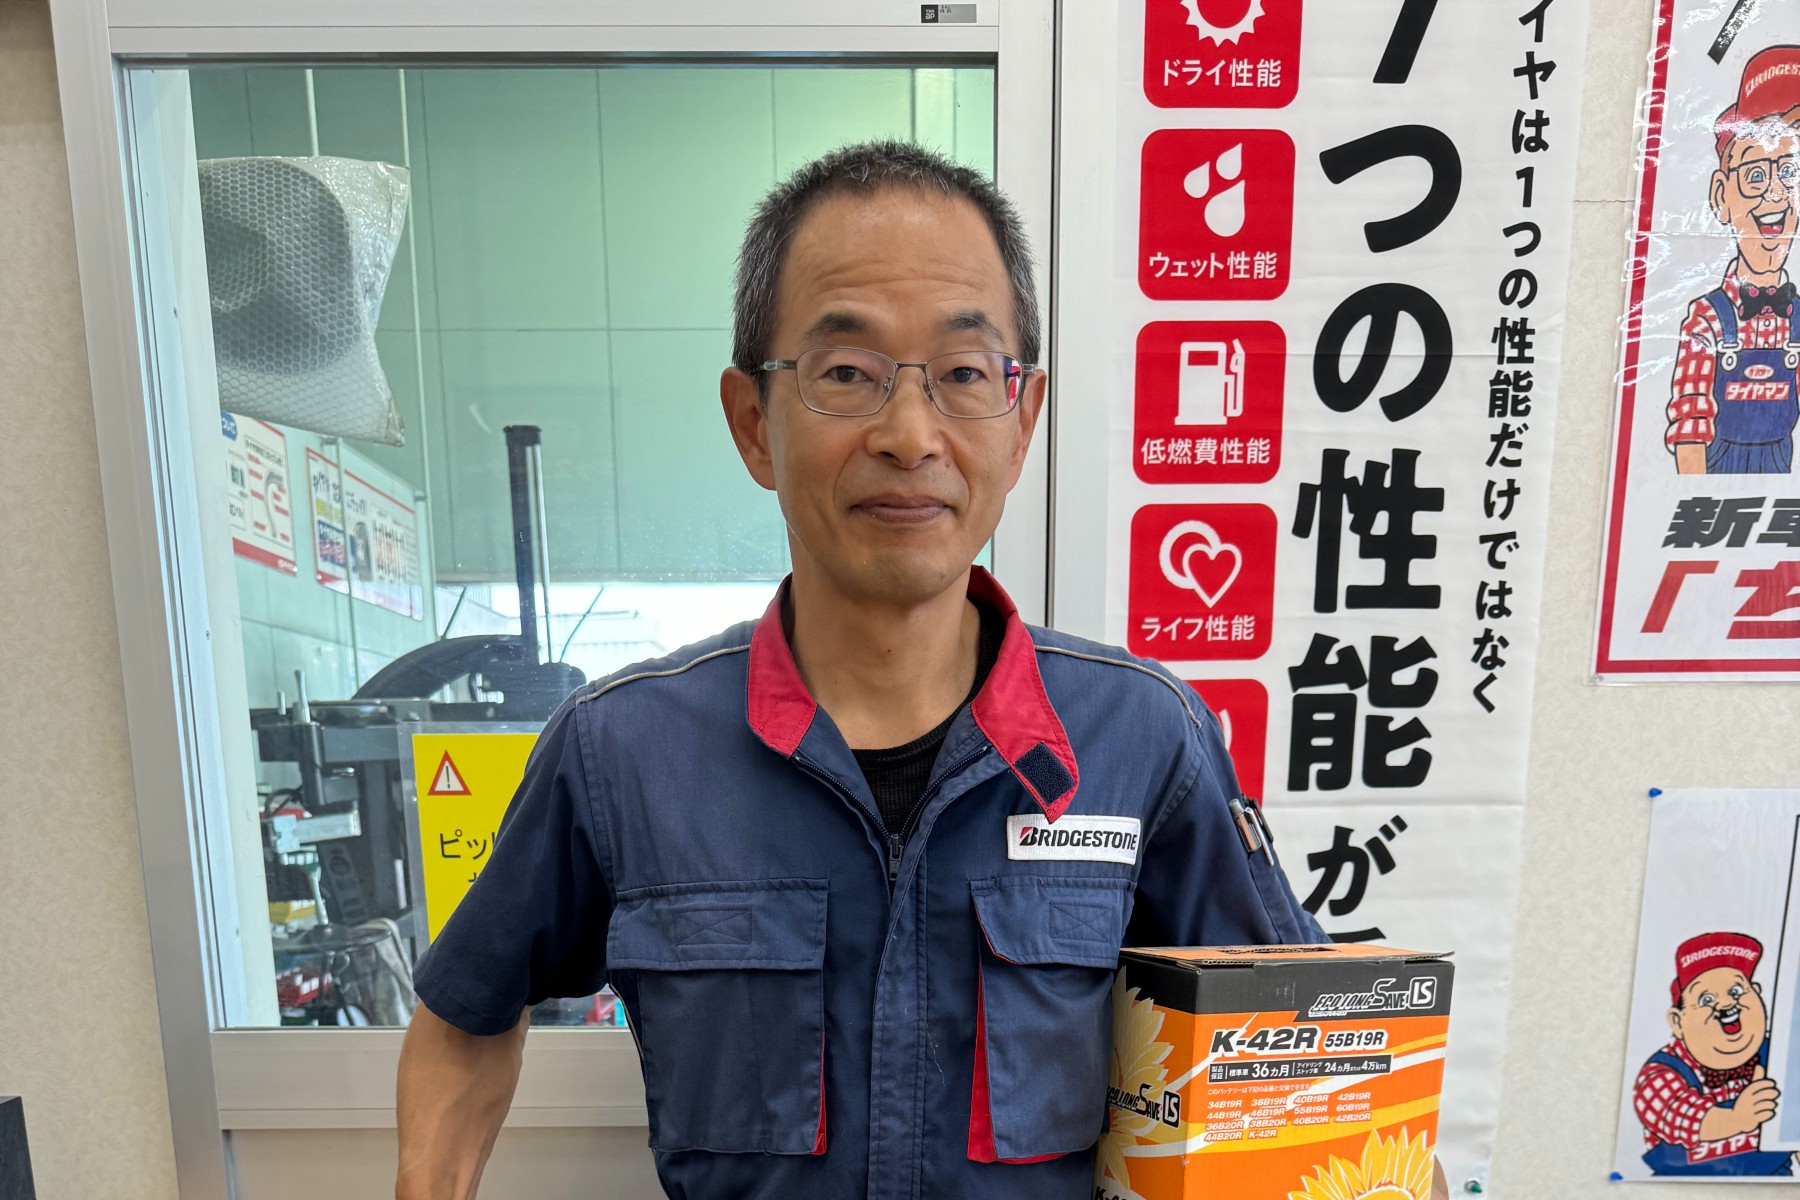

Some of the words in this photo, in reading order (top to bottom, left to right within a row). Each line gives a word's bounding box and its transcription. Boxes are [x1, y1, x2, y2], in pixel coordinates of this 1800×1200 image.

[1162, 59, 1282, 88] ドライ性能
[1745, 63, 1800, 97] BRIDGES
[1148, 251, 1278, 280] ウェット性能
[1726, 382, 1790, 400] タイヤマン
[1140, 437, 1271, 465] 低燃費性能
[1140, 615, 1256, 642] ライフ性能
[1019, 826, 1138, 851] BRIDGESTONE
[1680, 945, 1760, 968] BRIDGESTONE
[1210, 1026, 1318, 1053] K-42R
[1325, 1031, 1385, 1048] 55B19R
[1206, 1111, 1242, 1120] 44B19R
[1250, 1108, 1286, 1117] 46B19R
[1293, 1105, 1328, 1115] 55B19R
[1336, 1103, 1371, 1111] 60B19R
[1207, 1099, 1242, 1109] 34B19R
[1251, 1097, 1287, 1107] 38B19R
[1294, 1094, 1329, 1104] 40B19R
[1337, 1092, 1371, 1101] 42B19R
[1206, 1121, 1243, 1131] 36B20R
[1250, 1118, 1287, 1128] 38B20R
[1292, 1115, 1329, 1125] 40B20R
[1335, 1113, 1371, 1123] 42B20R
[1205, 1132, 1243, 1141] 44B20R
[1248, 1130, 1277, 1139] K-42R
